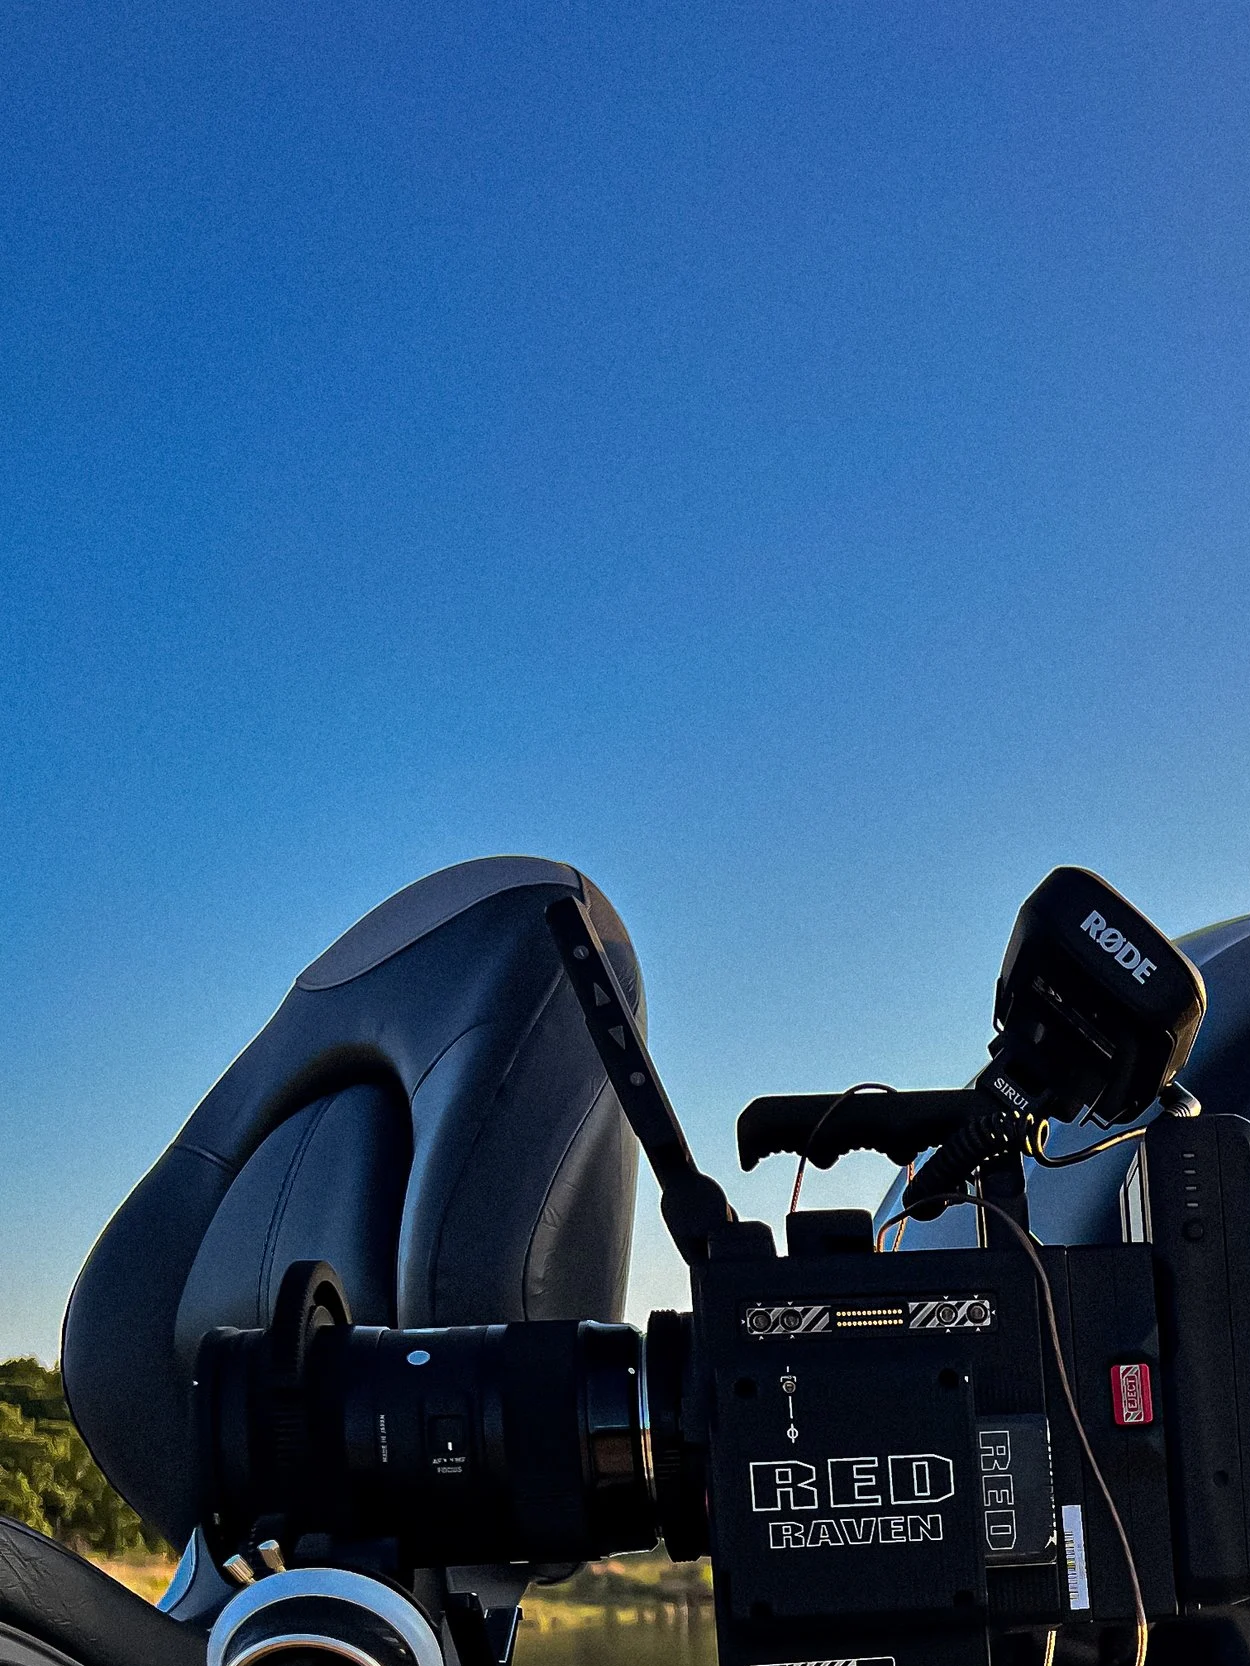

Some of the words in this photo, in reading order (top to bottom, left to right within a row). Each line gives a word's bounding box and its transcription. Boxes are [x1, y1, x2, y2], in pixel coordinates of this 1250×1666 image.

[1080, 910, 1157, 985] RØDE
[993, 1077, 1029, 1111] SIRUI
[1126, 1376, 1139, 1411] EJECT
[749, 1453, 954, 1512] RED
[979, 1430, 1017, 1551] RED
[769, 1513, 943, 1549] RAVEN
